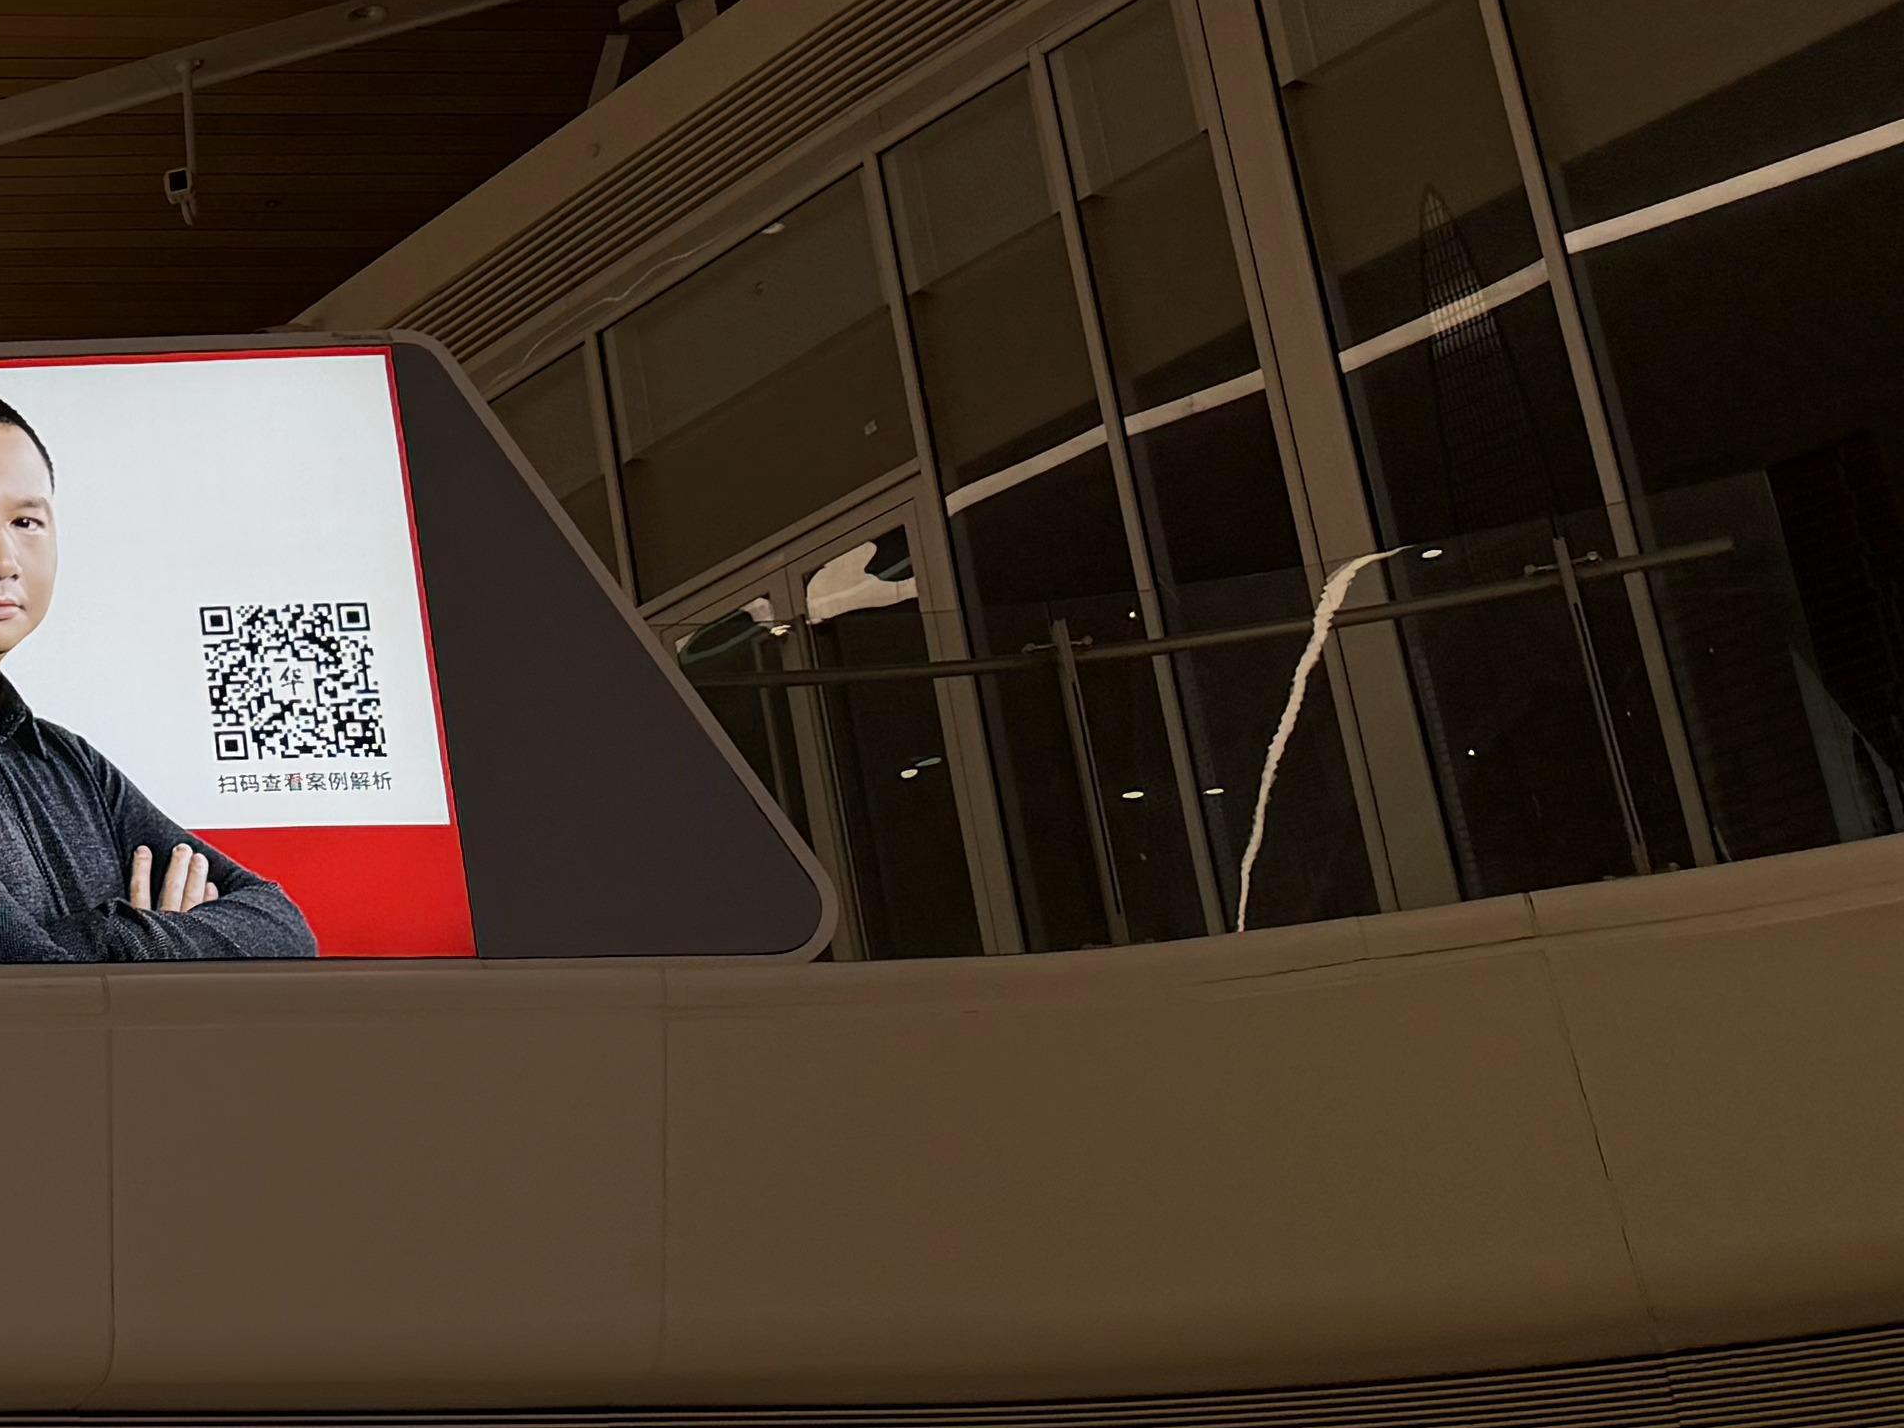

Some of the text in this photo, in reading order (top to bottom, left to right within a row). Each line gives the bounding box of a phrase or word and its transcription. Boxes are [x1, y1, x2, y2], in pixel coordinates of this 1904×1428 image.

[217, 771, 393, 793] 扫码查看案例解析
